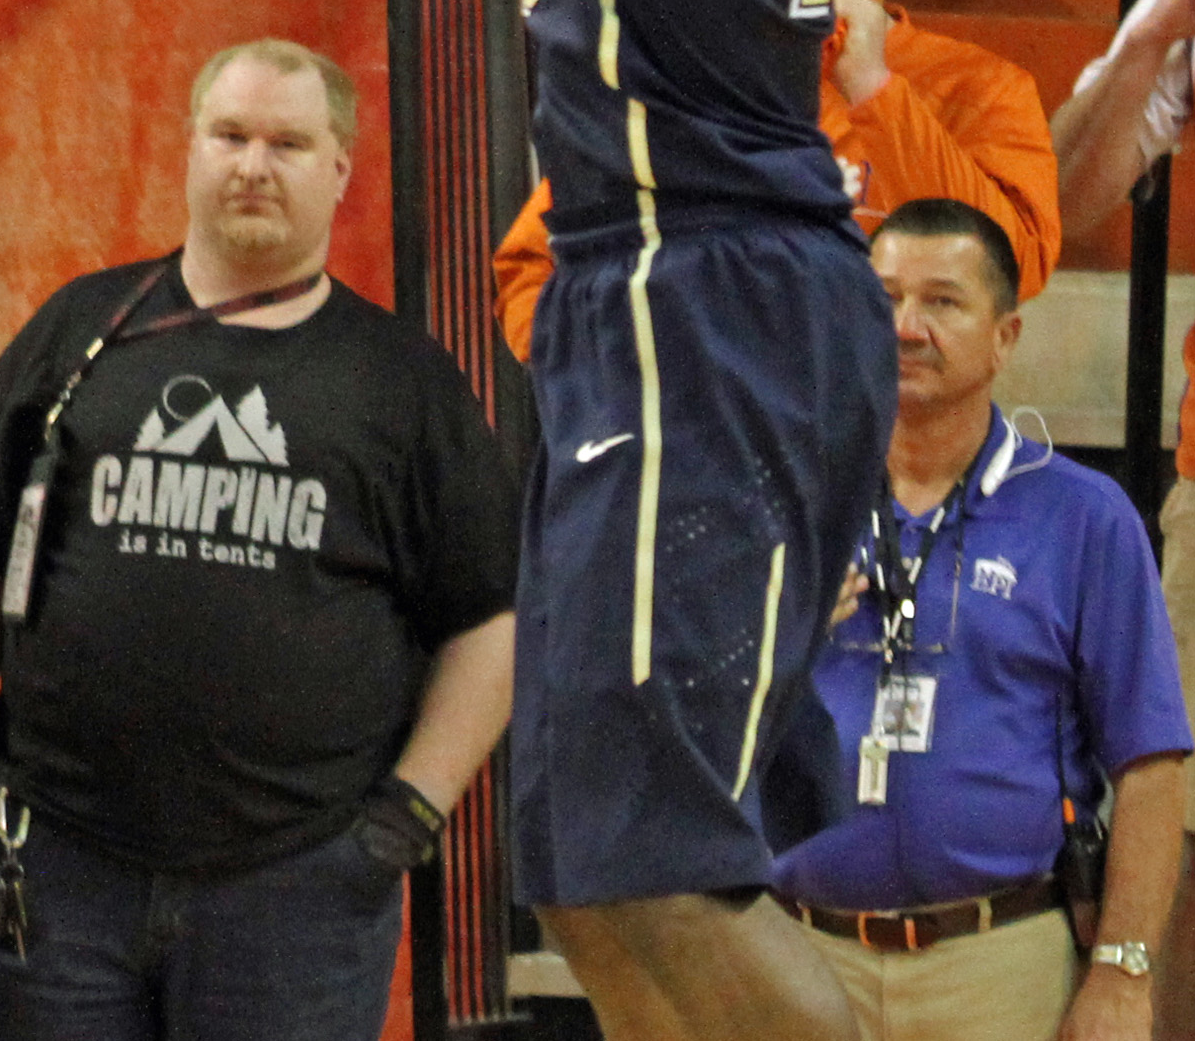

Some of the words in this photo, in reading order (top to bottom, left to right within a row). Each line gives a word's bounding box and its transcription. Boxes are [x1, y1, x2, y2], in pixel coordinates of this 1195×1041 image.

[90, 454, 327, 550] CAMPING
[119, 529, 147, 553] is
[155, 531, 188, 558] in
[199, 538, 276, 570] tents
